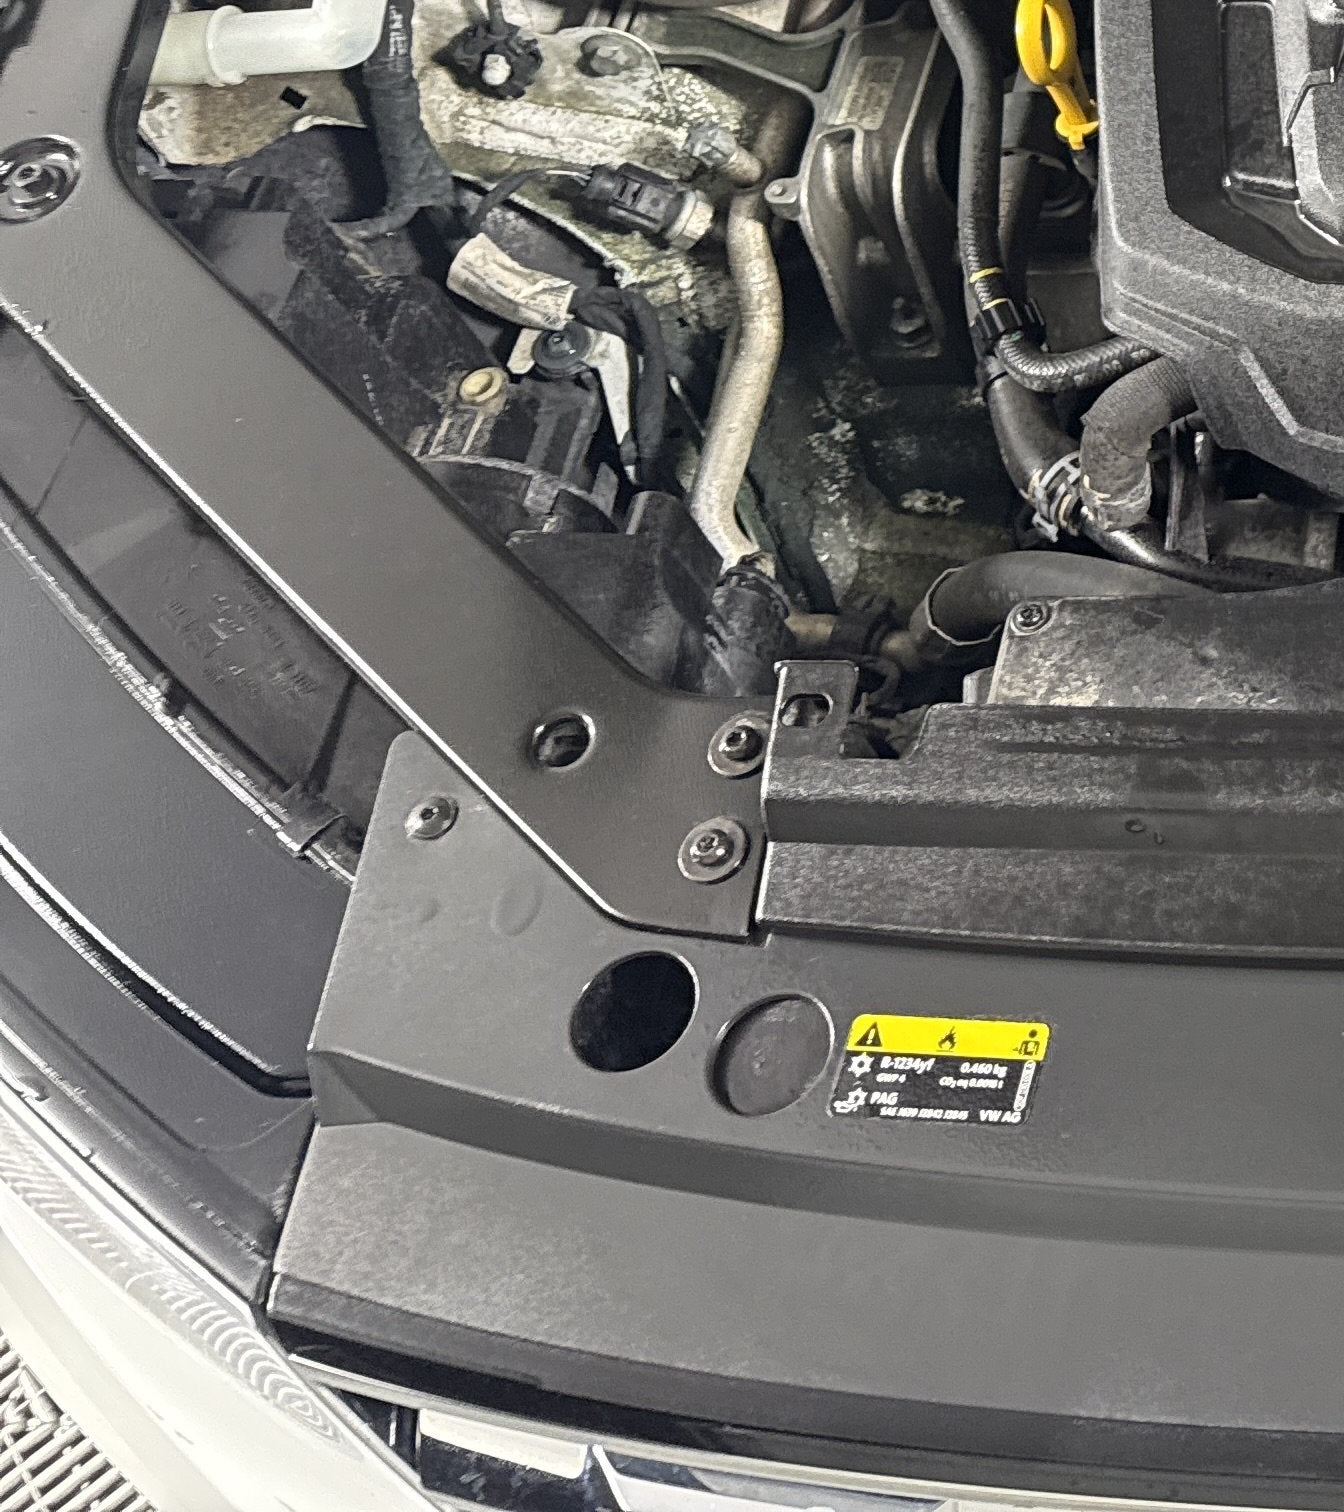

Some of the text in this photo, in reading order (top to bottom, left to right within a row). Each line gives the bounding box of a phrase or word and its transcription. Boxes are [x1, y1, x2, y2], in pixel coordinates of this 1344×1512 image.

[868, 1091, 899, 1105] PAG
[977, 1109, 1002, 1122] VW
[1000, 1110, 1022, 1123] AG
